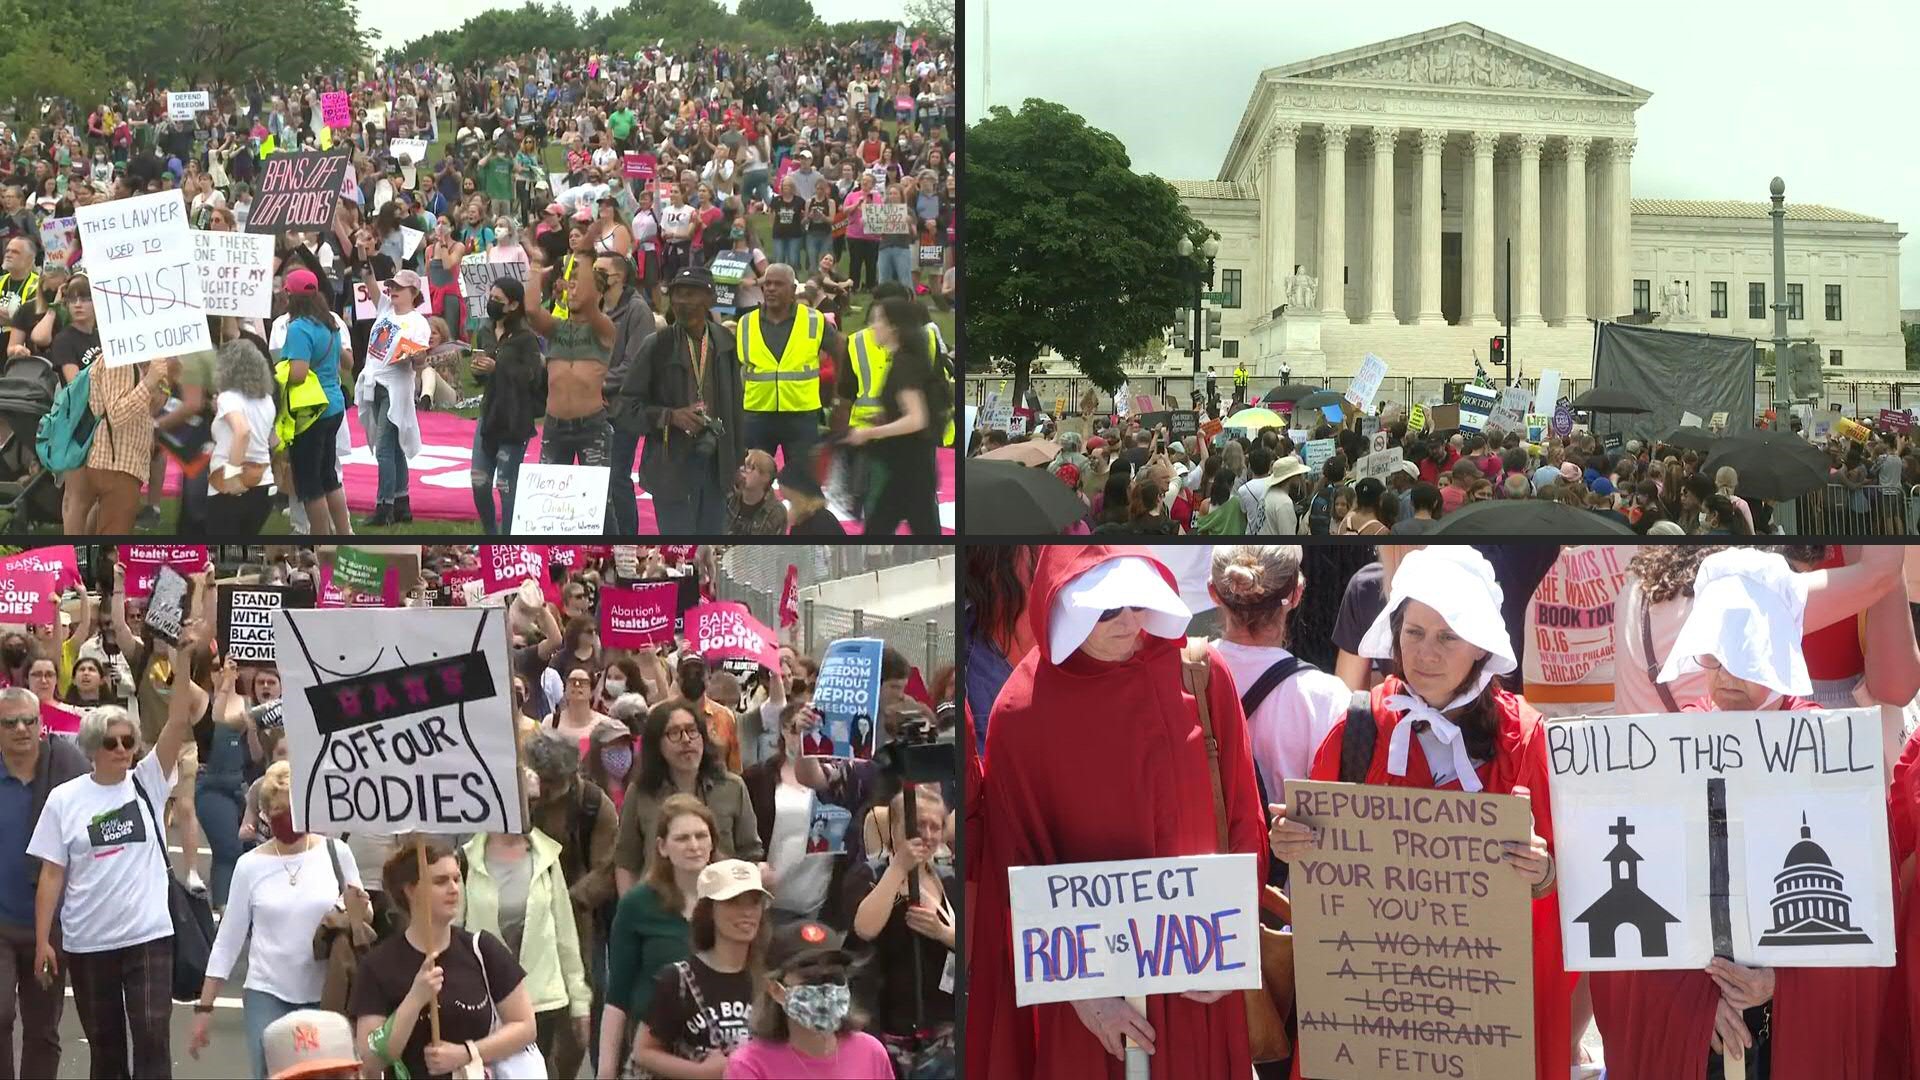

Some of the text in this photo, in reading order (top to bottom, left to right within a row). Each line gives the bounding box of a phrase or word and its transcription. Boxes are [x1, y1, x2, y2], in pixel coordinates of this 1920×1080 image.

[172, 101, 205, 109] FREEDOM
[175, 93, 202, 101] DEFEND
[262, 157, 309, 192] BANS
[303, 155, 346, 189] OFF
[250, 190, 334, 225] OUR BODIES
[83, 201, 179, 233] THIS LAWYER
[106, 238, 161, 258] USED TO
[195, 234, 210, 247] EN
[194, 248, 216, 261] ONE
[217, 266, 240, 279] OFF
[248, 268, 266, 282] MY
[461, 261, 530, 285] REGULATE
[95, 262, 190, 324] TRUST
[201, 279, 259, 297] UGHTERS'
[107, 323, 202, 357] THIS COURT
[1461, 394, 1493, 409] ABORTION
[1467, 414, 1477, 424] IS
[1527, 416, 1547, 426] LIFE
[526, 472, 555, 490] Men
[130, 547, 199, 559] Health Care.
[491, 545, 528, 557] BANS
[492, 551, 519, 568] OFF
[520, 551, 542, 568] OUR
[555, 550, 575, 560] OUR
[6, 555, 41, 571] BANS
[1602, 547, 1620, 574] IT
[0, 578, 15, 591] NS
[1535, 576, 1559, 603] SHE
[1565, 578, 1610, 608] WANTS
[5, 591, 40, 603] OUR
[234, 593, 280, 607] STAND
[0, 601, 33, 614] DIES
[611, 605, 654, 617] Abortion
[1538, 602, 1615, 628] BOOK TOU
[233, 611, 269, 624] WITH
[611, 617, 650, 628] Health
[700, 611, 743, 627] BANS
[232, 628, 275, 641] BLACK
[698, 624, 731, 639] OFF
[1535, 627, 1569, 653] 10.16
[231, 646, 275, 659] WOME
[1540, 652, 1559, 663] NEW
[1560, 652, 1581, 664] YORK
[1582, 644, 1615, 661] PHILADE
[1541, 661, 1590, 682] CHICAGO
[335, 665, 465, 717] BANS
[813, 687, 869, 704] REPRO
[331, 716, 459, 773] OFF OUR
[1548, 723, 1656, 775] BUILD
[1669, 733, 1743, 774] THIS
[1755, 716, 1874, 774] WALL
[324, 772, 491, 823] BODIES
[1294, 789, 1498, 826] REPUBLICANS
[116, 819, 134, 831] OUR
[1047, 867, 1198, 908] PROTECT
[1299, 860, 1490, 898] YOUR RIGHTS
[1320, 894, 1470, 927] IF YOU'RE
[1022, 924, 1104, 982] ROE
[1128, 908, 1245, 978] WADE
[1336, 930, 1494, 960] A WOMAN
[1338, 958, 1503, 995] A TEACHER
[1365, 988, 1456, 1018] LGBTQ
[1301, 1011, 1511, 1047] AN IMMIGRANT
[1334, 1042, 1464, 1078] A FETUS
